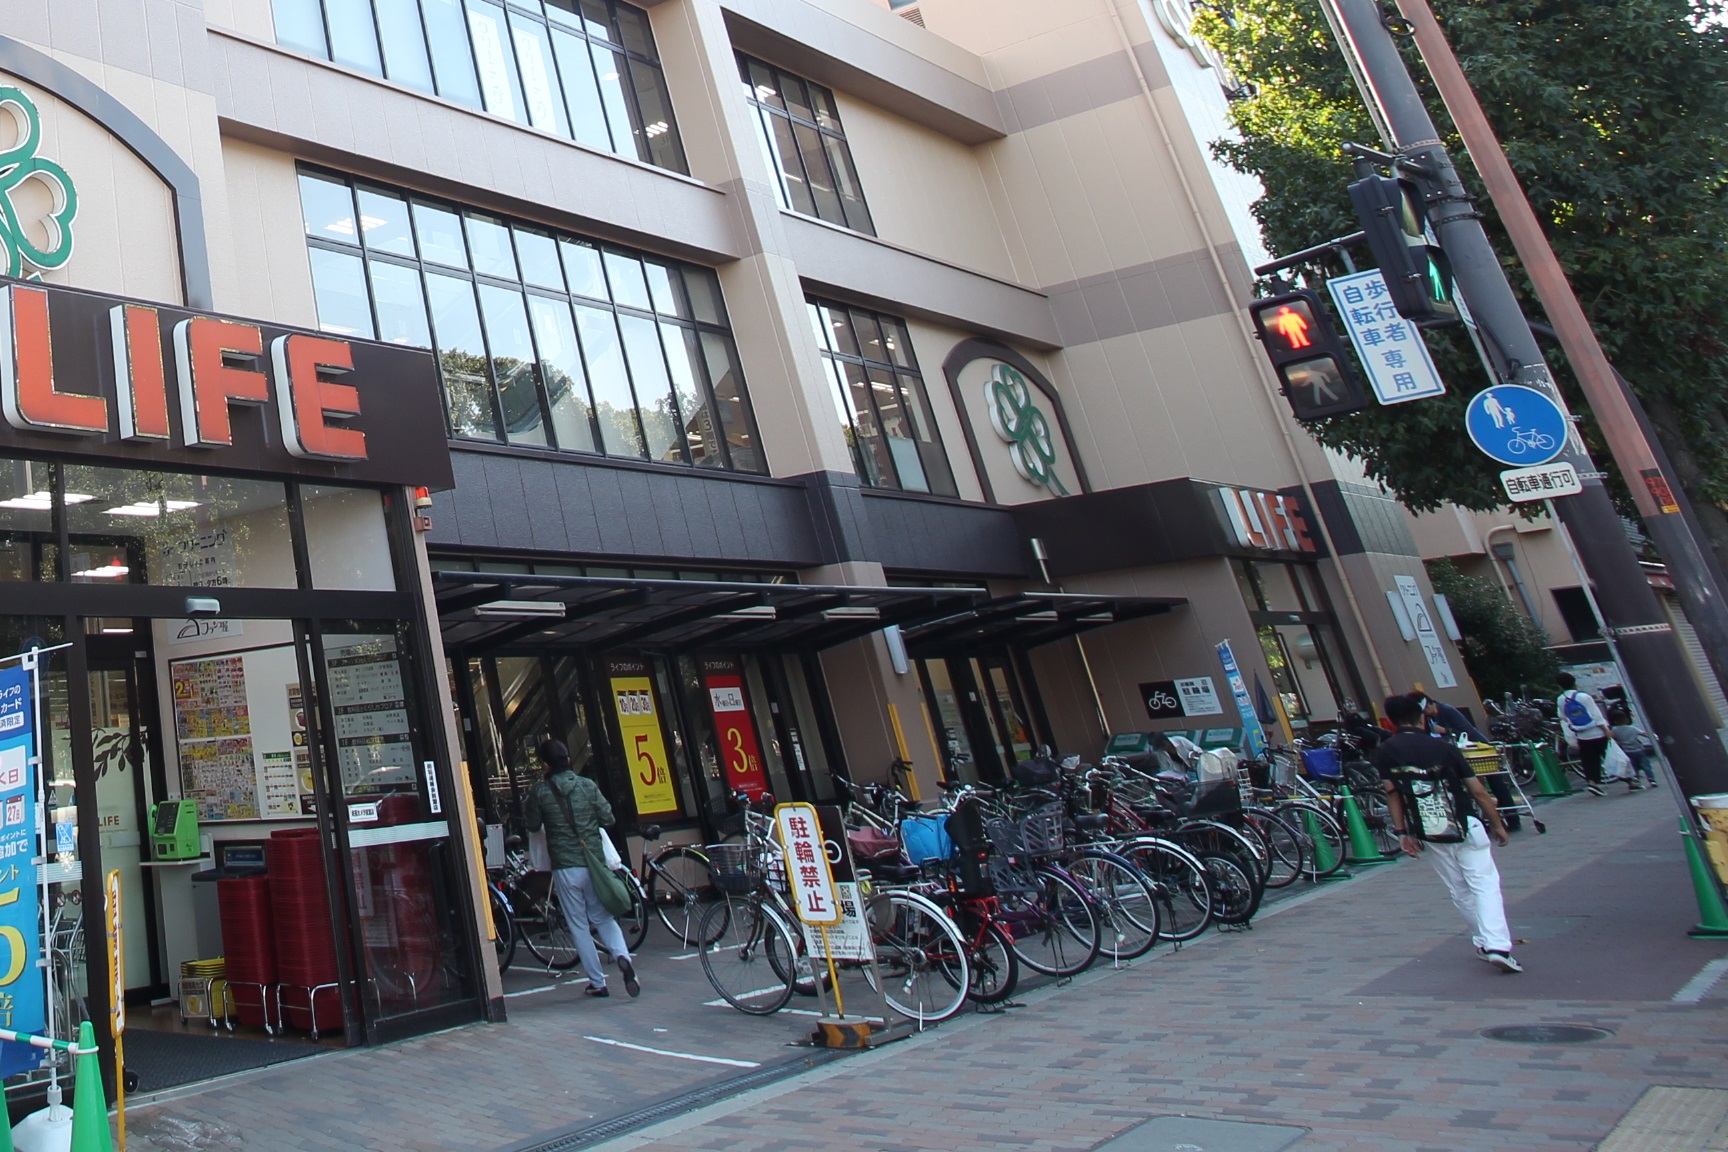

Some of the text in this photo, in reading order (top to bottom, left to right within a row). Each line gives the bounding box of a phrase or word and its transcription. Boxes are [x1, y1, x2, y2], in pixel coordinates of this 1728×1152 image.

[1506, 469, 1575, 494] 自転車通行可
[1218, 487, 1316, 552] LIFE
[7, 805, 20, 822] 27日
[788, 816, 827, 913] 駐輪禁止
